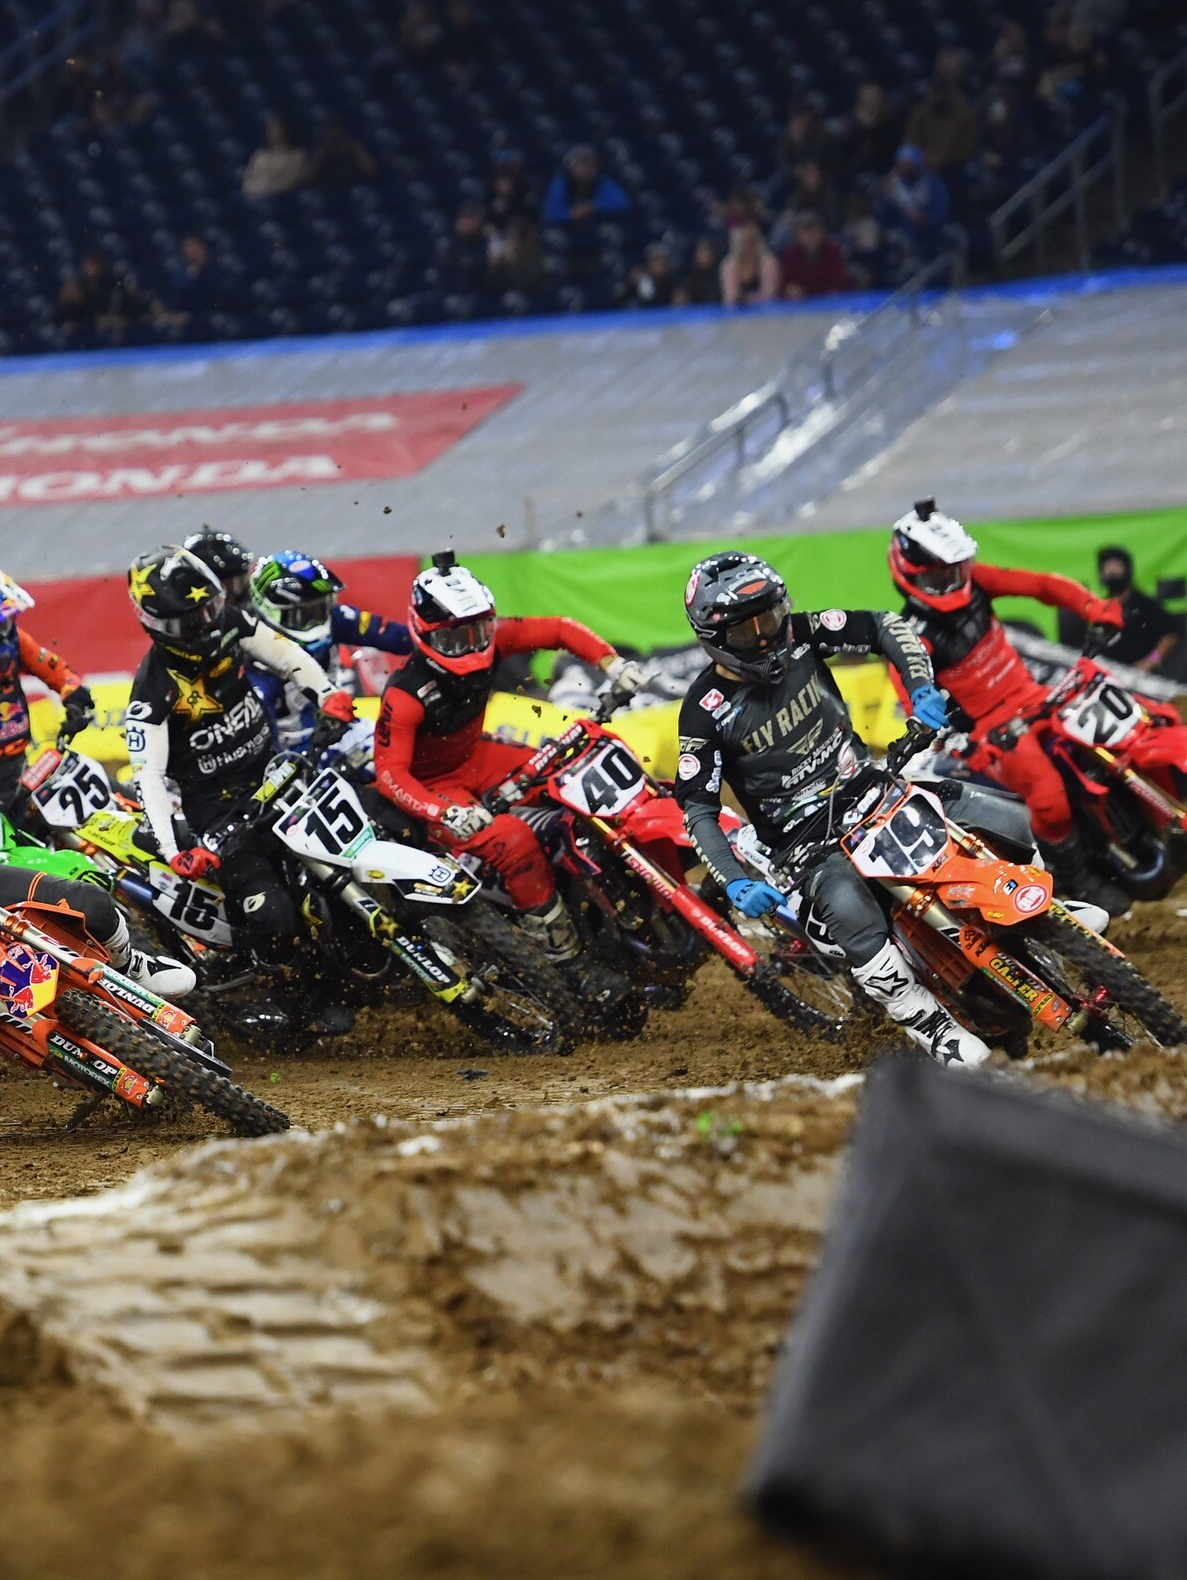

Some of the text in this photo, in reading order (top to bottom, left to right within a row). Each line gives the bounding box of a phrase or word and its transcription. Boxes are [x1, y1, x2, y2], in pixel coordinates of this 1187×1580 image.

[741, 720, 774, 755] FLY
[1077, 683, 1133, 744] 20
[581, 747, 643, 815] 40
[791, 755, 812, 776] ROCKY
[58, 764, 111, 825] 25
[868, 793, 949, 877] 19
[169, 879, 219, 931] 15
[735, 882, 755, 902] FLY
[396, 935, 451, 983] DUNLOP
[50, 1034, 118, 1075] DUNOP
[64, 1055, 111, 1087] MOTOREX
